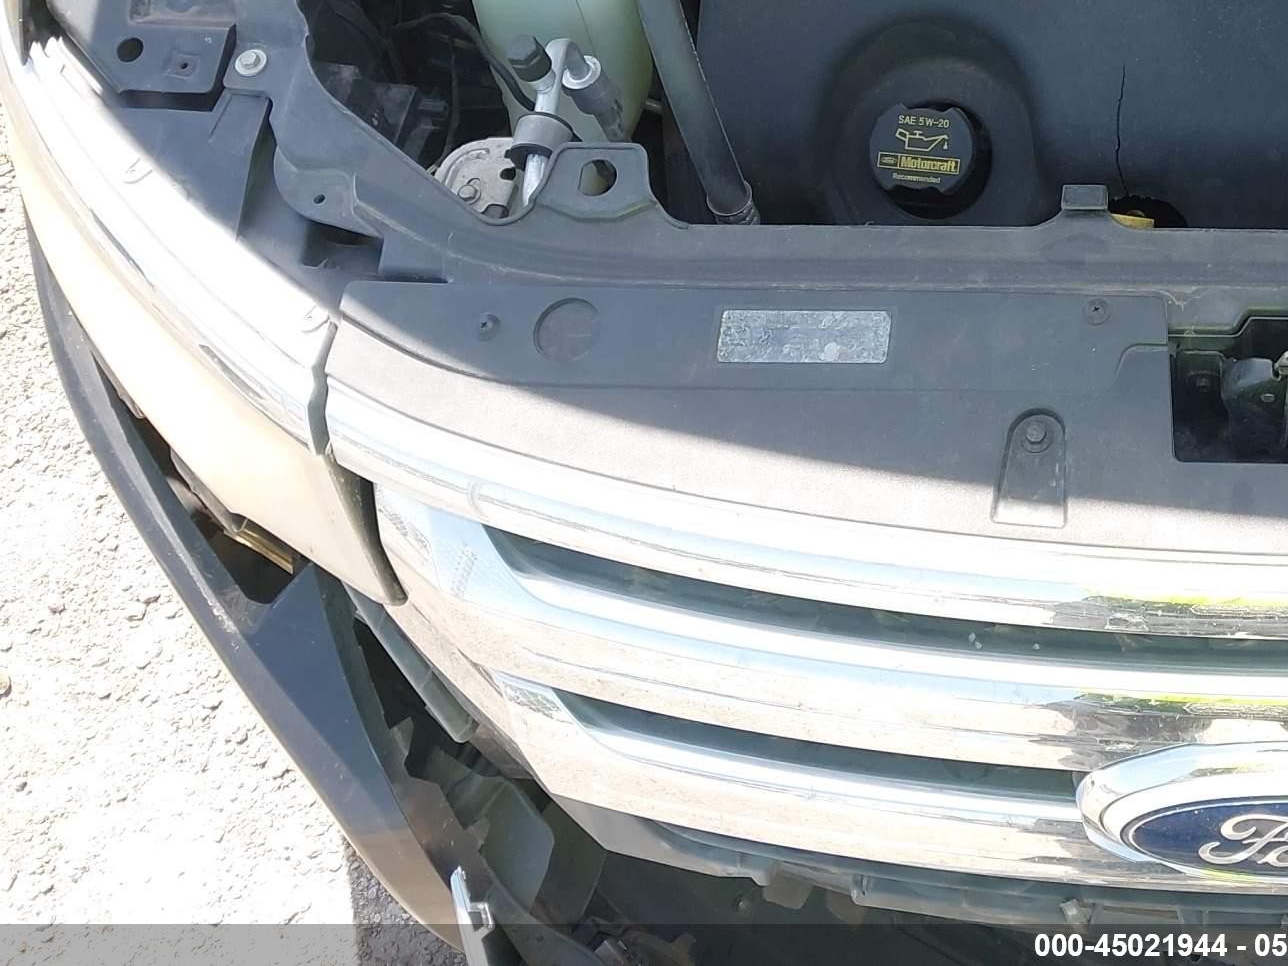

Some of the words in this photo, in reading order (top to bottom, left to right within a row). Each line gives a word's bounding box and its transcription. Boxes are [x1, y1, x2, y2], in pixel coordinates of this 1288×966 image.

[898, 115, 917, 125] SAE
[918, 117, 950, 128] 5W-20
[900, 156, 957, 172] Motorcraft
[892, 173, 941, 183] Recommended
